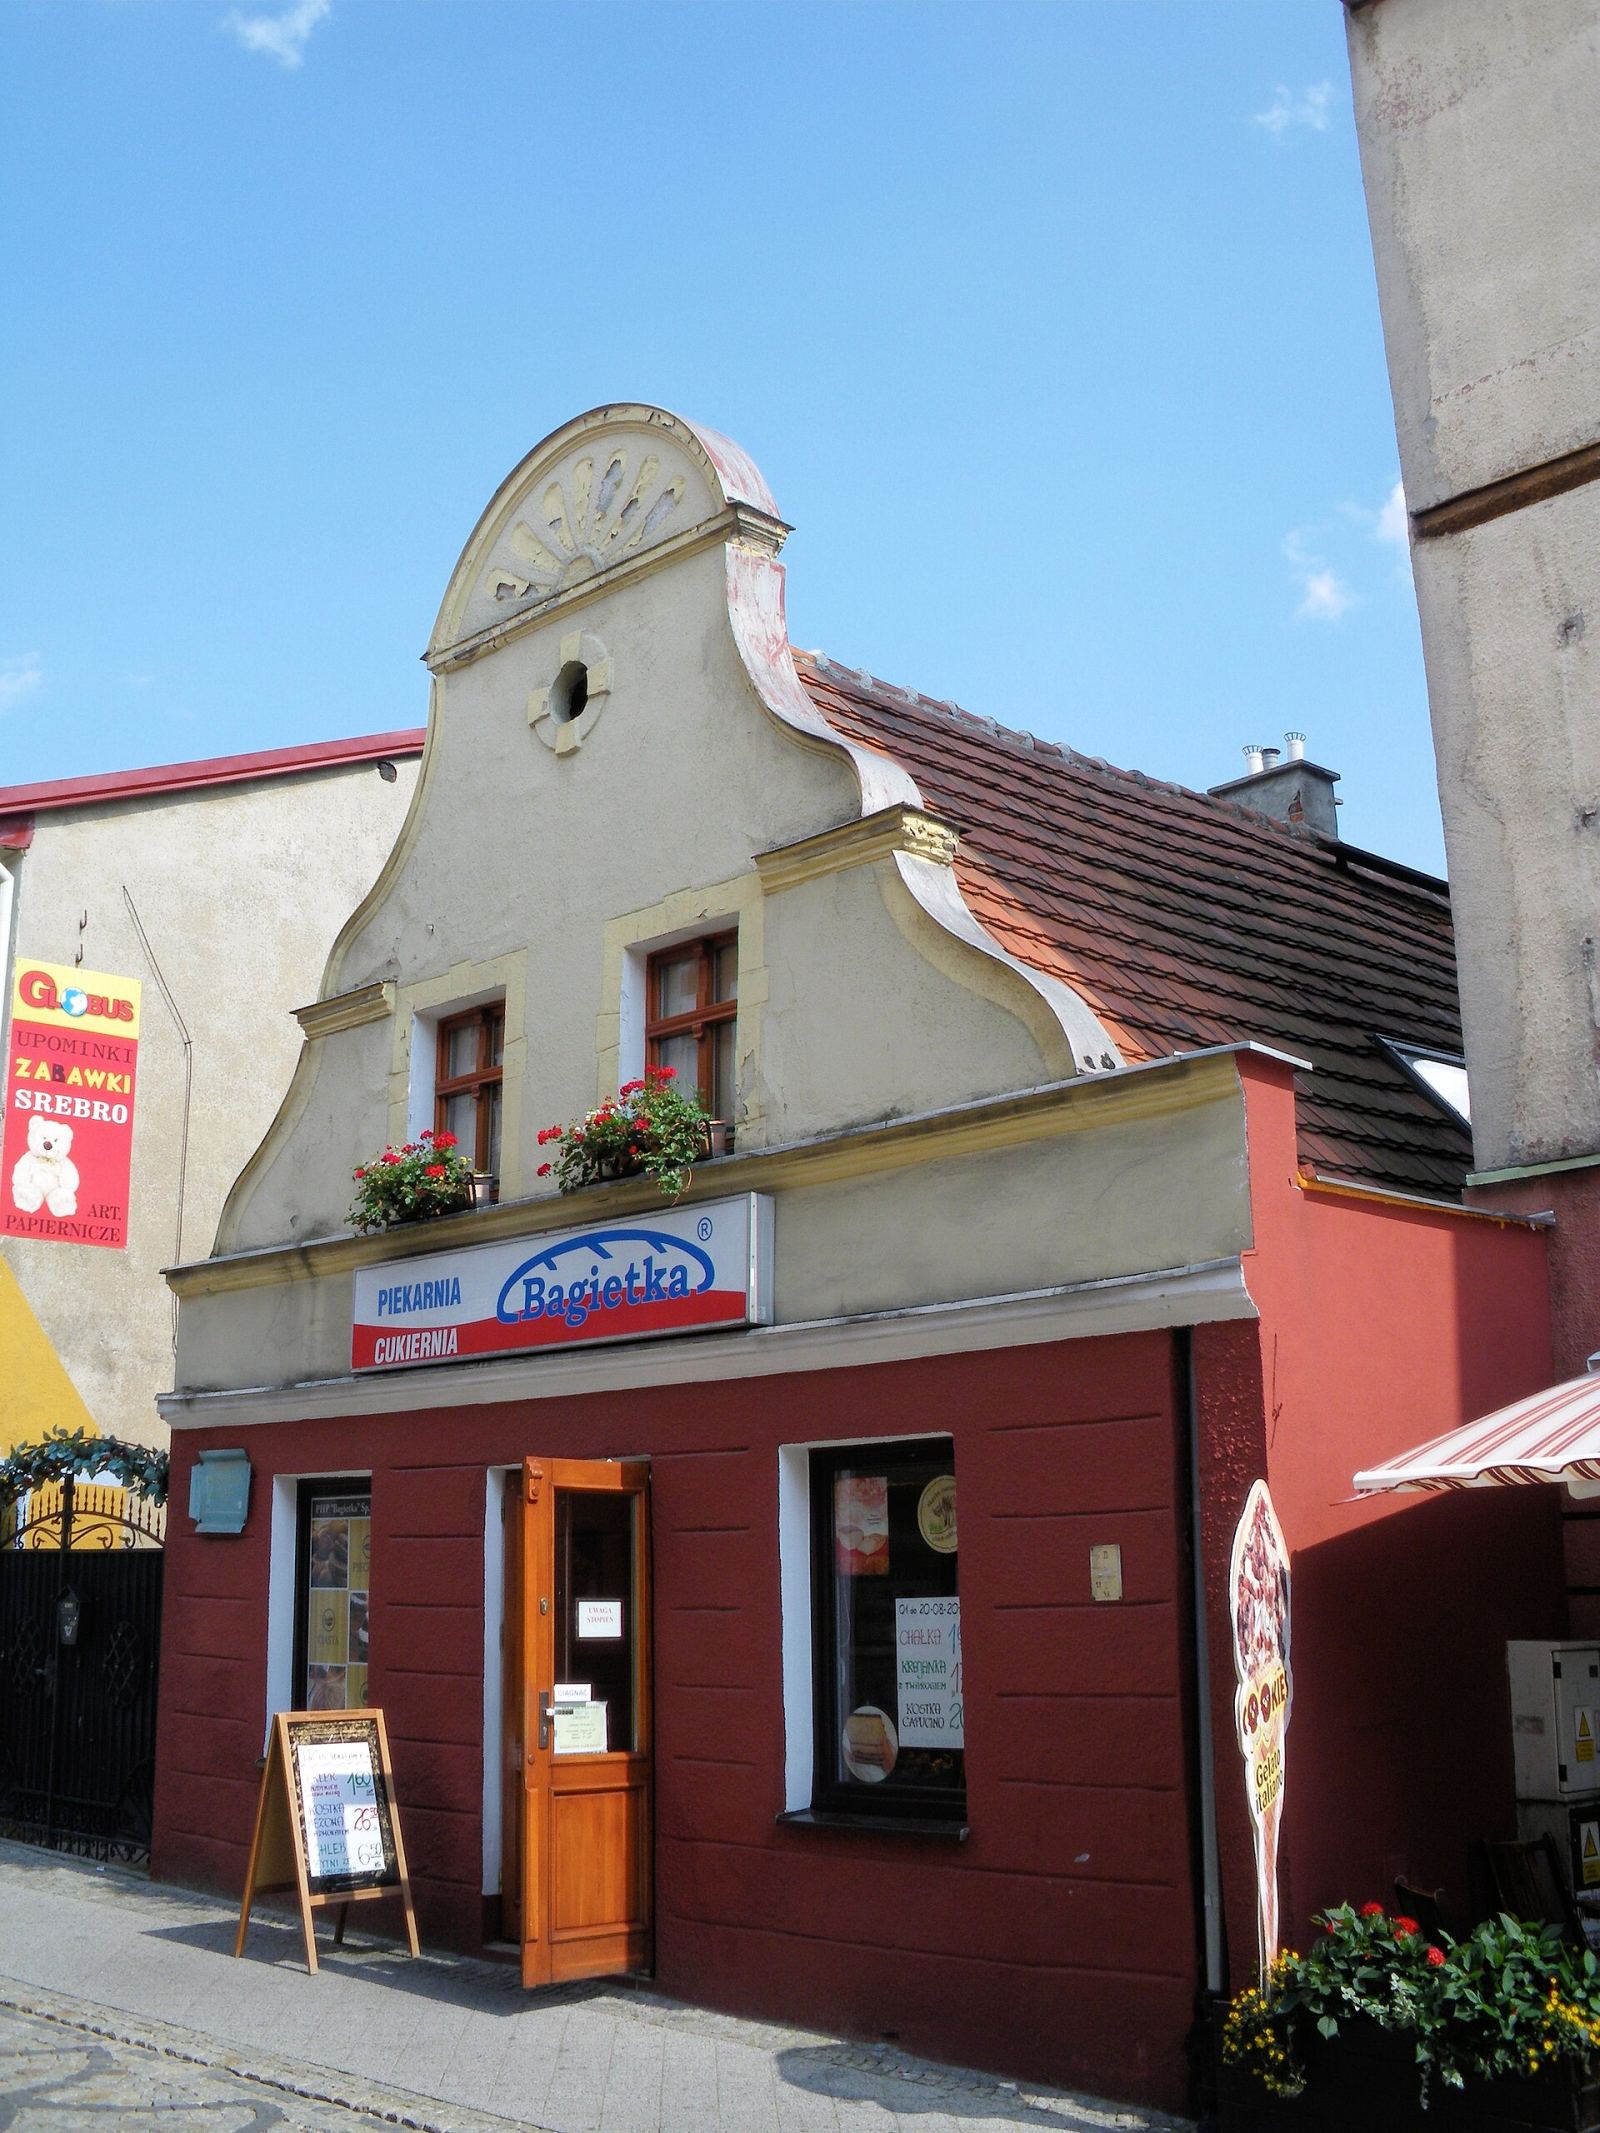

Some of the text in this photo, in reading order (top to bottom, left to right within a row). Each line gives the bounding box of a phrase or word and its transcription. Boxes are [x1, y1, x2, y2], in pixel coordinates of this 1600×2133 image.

[18, 970, 135, 1022] GLOBUS
[16, 1030, 133, 1064] UPOMINKI
[15, 1057, 131, 1095] ZABAWKI
[14, 1088, 129, 1124] SREBRO
[5, 1214, 121, 1242] PAPIERNICZE
[87, 1203, 122, 1221] ART.
[377, 1277, 461, 1317] PIEKARNIA
[521, 1255, 691, 1327] Bagietka
[374, 1328, 458, 1365] CUKIERNIA
[906, 1703, 941, 1715] KOSTKA
[1256, 1749, 1281, 1788] Gelato
[1256, 1769, 1283, 1815] italiano
